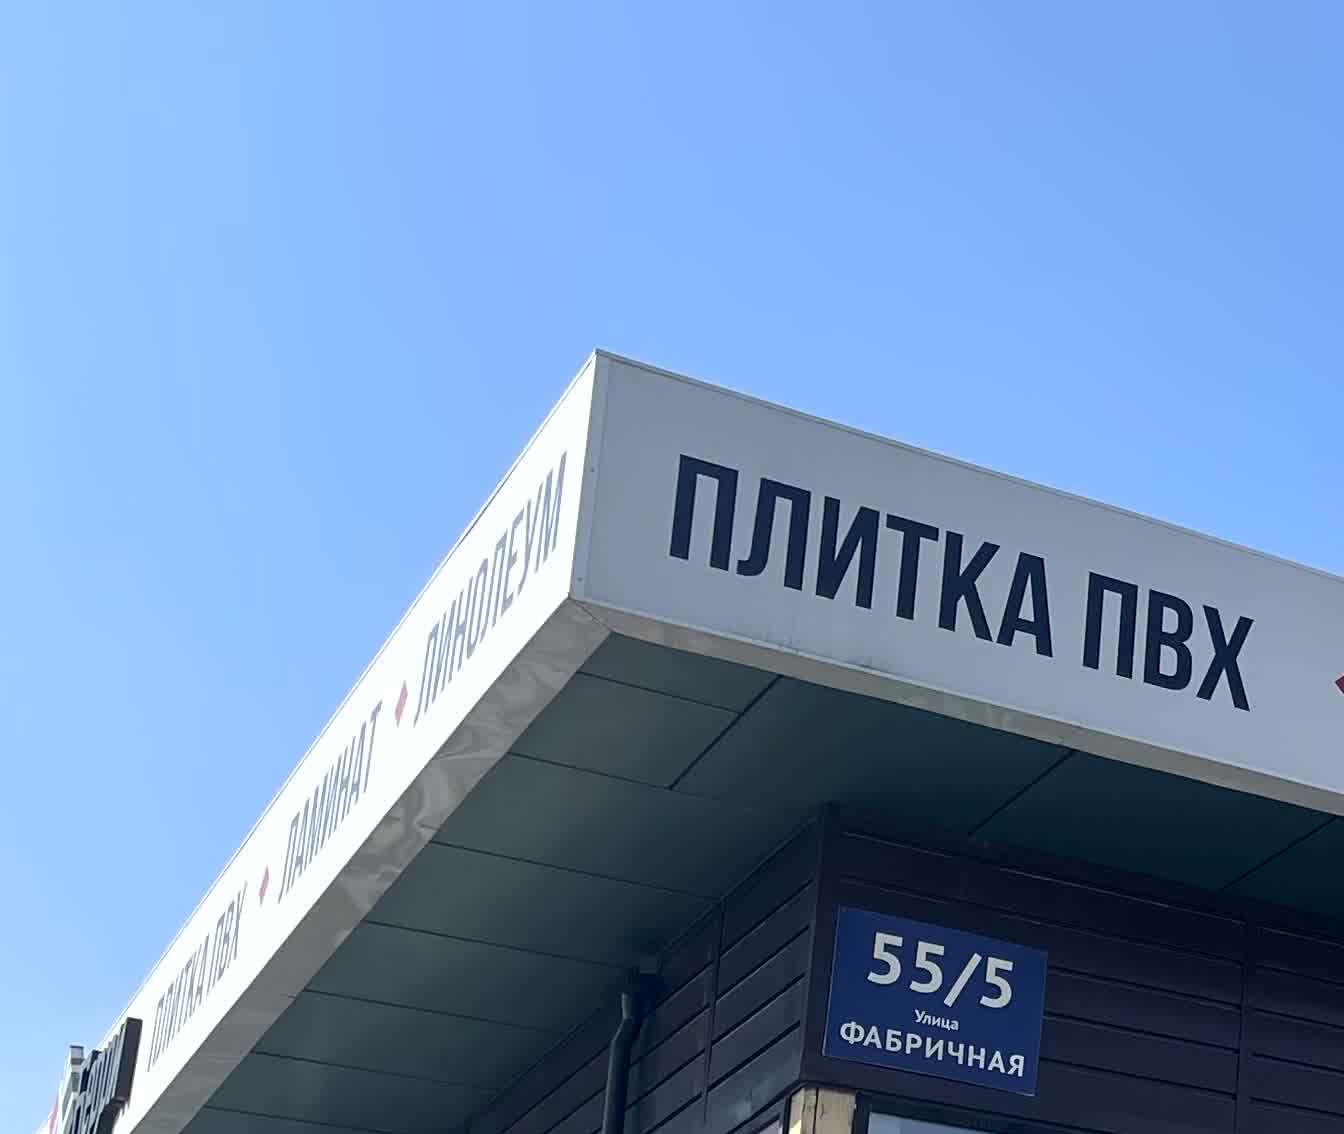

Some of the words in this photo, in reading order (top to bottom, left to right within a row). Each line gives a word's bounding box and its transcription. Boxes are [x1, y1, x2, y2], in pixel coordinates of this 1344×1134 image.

[413, 449, 568, 728] ЛИНОЛЕУМ
[668, 453, 1053, 657] ПЛИТКА
[1082, 571, 1255, 712] ПВХ
[277, 699, 383, 904] ЛАМИНАТ
[866, 931, 1014, 1009] 55/5
[914, 1009, 960, 1031] Улица
[839, 1021, 1025, 1077] ФАБРИЧНАЯ
